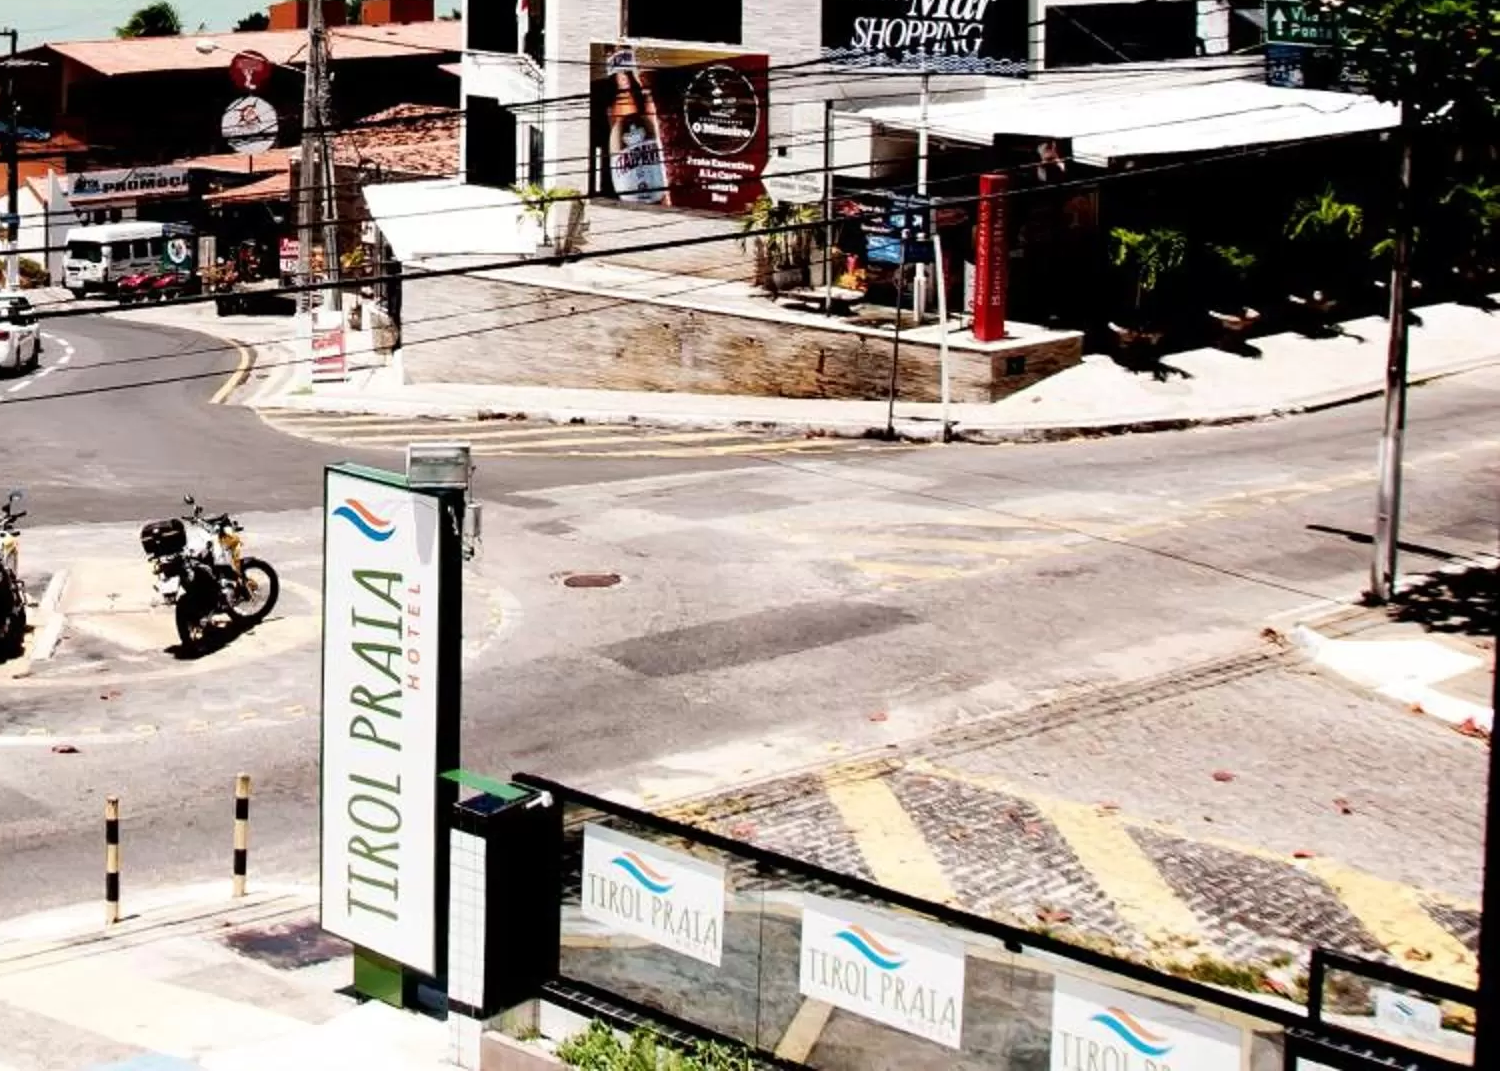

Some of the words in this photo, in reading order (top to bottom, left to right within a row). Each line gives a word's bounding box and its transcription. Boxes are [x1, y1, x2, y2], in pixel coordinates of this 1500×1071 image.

[851, 17, 984, 55] SHOPPING
[350, 569, 403, 752] PRAIA
[407, 583, 421, 691] HOTEL
[348, 774, 402, 921] TIROL
[588, 872, 644, 923] TIROL
[650, 895, 719, 949] PRAIA
[808, 947, 873, 1002] TIROL
[879, 971, 957, 1031] PRAIA
